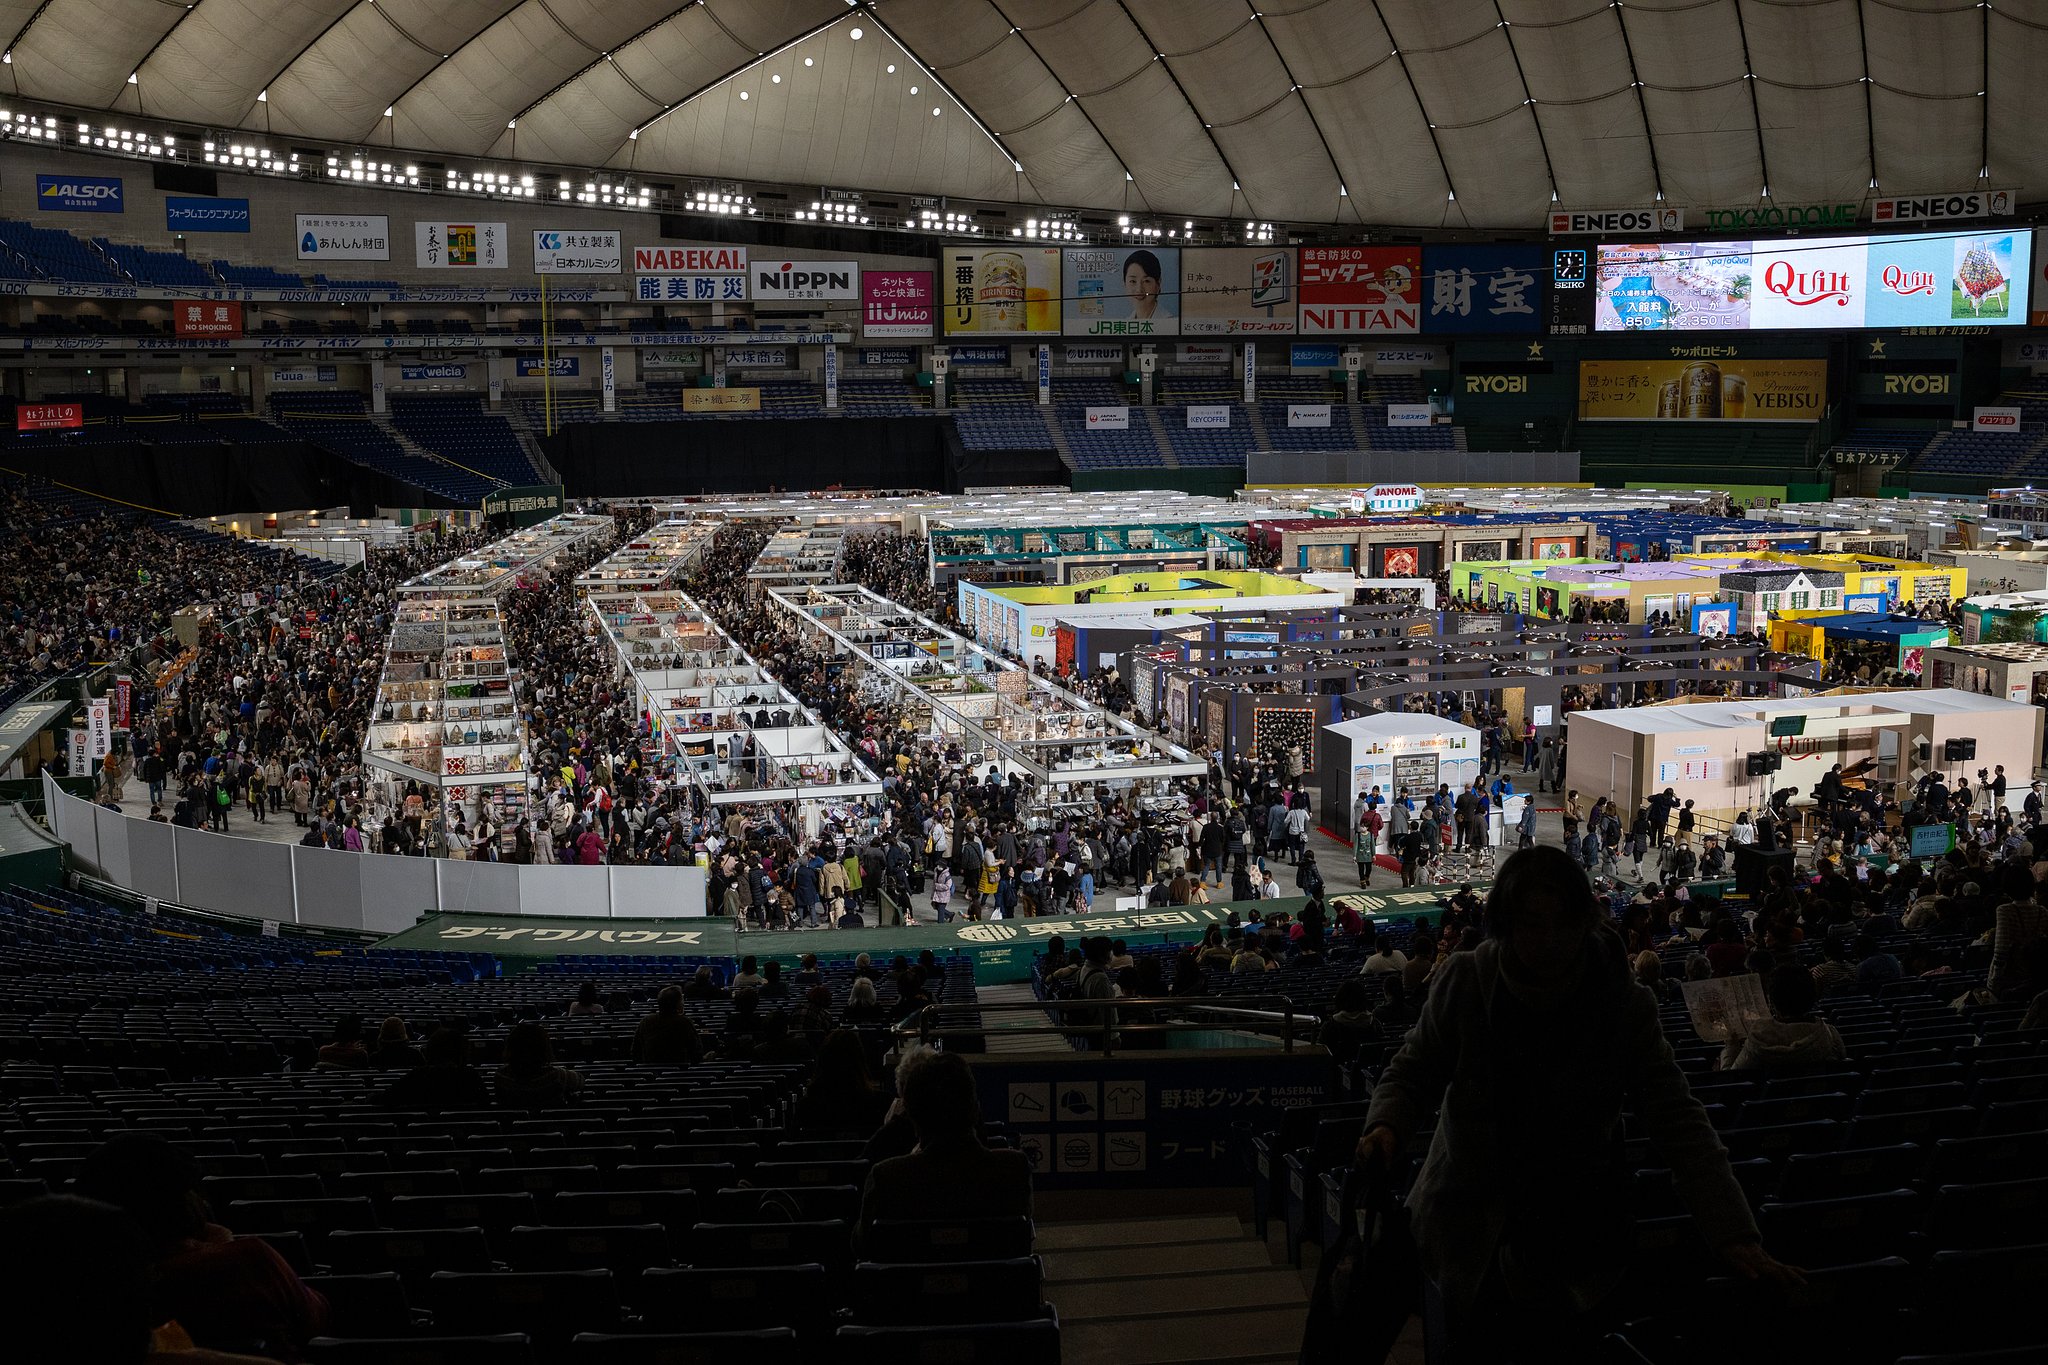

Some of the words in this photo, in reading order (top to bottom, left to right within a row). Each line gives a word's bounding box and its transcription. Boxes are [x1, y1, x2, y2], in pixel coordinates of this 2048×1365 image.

[58, 184, 120, 200] ALSOK
[1896, 196, 1980, 218] ENEOS
[168, 208, 248, 220] フォーラムエンジニアリング
[1705, 206, 1783, 228] TOKYO
[1788, 205, 1856, 226] DOME
[301, 219, 370, 231] 「経営」を守る・支える
[1572, 213, 1652, 230] ENEOS
[319, 237, 385, 250] あんしん財団
[566, 238, 616, 252] 共立製薬
[1304, 250, 1362, 261] 総合防災の
[556, 257, 620, 268] 日本カルミック
[760, 262, 849, 290] NIPPN
[1187, 273, 1213, 281] 日本の
[1303, 263, 1375, 282] ニッタン
[881, 277, 915, 288] ネットを
[1555, 282, 1585, 291] SEIKO
[1764, 261, 1851, 306] Quilt
[1883, 266, 1935, 295] Quilt
[57, 285, 138, 298] 日本ステージ株式会社
[640, 278, 743, 299] 能美防災
[789, 290, 824, 298] 日本製粉
[872, 288, 926, 298] もっと快適に
[956, 256, 974, 325] 一番搾り
[981, 289, 1003, 298] KIRIN
[1005, 289, 1024, 297] BEER
[1431, 267, 1534, 317] 財宝
[279, 291, 322, 302] DUSKIN
[327, 291, 371, 302] DUSKIN
[389, 292, 486, 302] 東京ドームファシリティーズ
[1554, 295, 1560, 303] B
[1627, 303, 1661, 313] 入館料
[1709, 303, 1720, 311] が
[188, 306, 229, 323] 禁煙
[1304, 309, 1416, 329] NITTAN
[185, 323, 197, 331] NO
[198, 323, 233, 332] SMOKING
[1089, 321, 1154, 335] JR東日本
[1550, 325, 1587, 335] 読売新聞
[261, 338, 306, 348] アイホン
[316, 338, 363, 348] アイホン
[449, 338, 484, 347] スチール
[645, 335, 726, 344] 中部衛生検査センター
[809, 334, 834, 343] 小泉
[728, 350, 786, 364] 大塚商会
[966, 349, 1007, 360] 明治機械
[1293, 351, 1338, 361] 文化シヤッター
[1670, 346, 1738, 357] サッポロビール
[936, 360, 945, 368] 14
[1144, 358, 1150, 367] 4
[1348, 357, 1357, 366] 16
[427, 366, 462, 377] welcia
[825, 351, 835, 390] 高砂熱学工業
[1039, 350, 1049, 387] 阪和興業
[275, 372, 303, 381] Fuua
[716, 377, 725, 385] 49
[1588, 375, 1656, 388] 豊かに香る、
[374, 383, 384, 391] 47
[1465, 376, 1527, 393] RYOBI
[1761, 380, 1808, 391] Premium
[1885, 375, 1949, 393] RYOBI
[1586, 391, 1641, 403] 深いコク。
[1753, 393, 1818, 408] YEBISU
[39, 407, 73, 419] うれしの
[1980, 416, 2013, 425] フコク生命
[1835, 452, 1901, 464] 日本アンテナ
[1374, 487, 1416, 496] JANOME
[537, 496, 558, 509] 免震
[95, 720, 106, 755] 日本通運
[1917, 830, 1948, 839] 西村由紀江
[1020, 908, 1233, 936] 東京西川
[439, 926, 703, 946] ダイワハウス
[1271, 1085, 1324, 1096] BASEBALL
[1160, 1087, 1265, 1109] 野球グッズ
[1271, 1097, 1313, 1107] GOODS
[1160, 1140, 1225, 1160] フード
